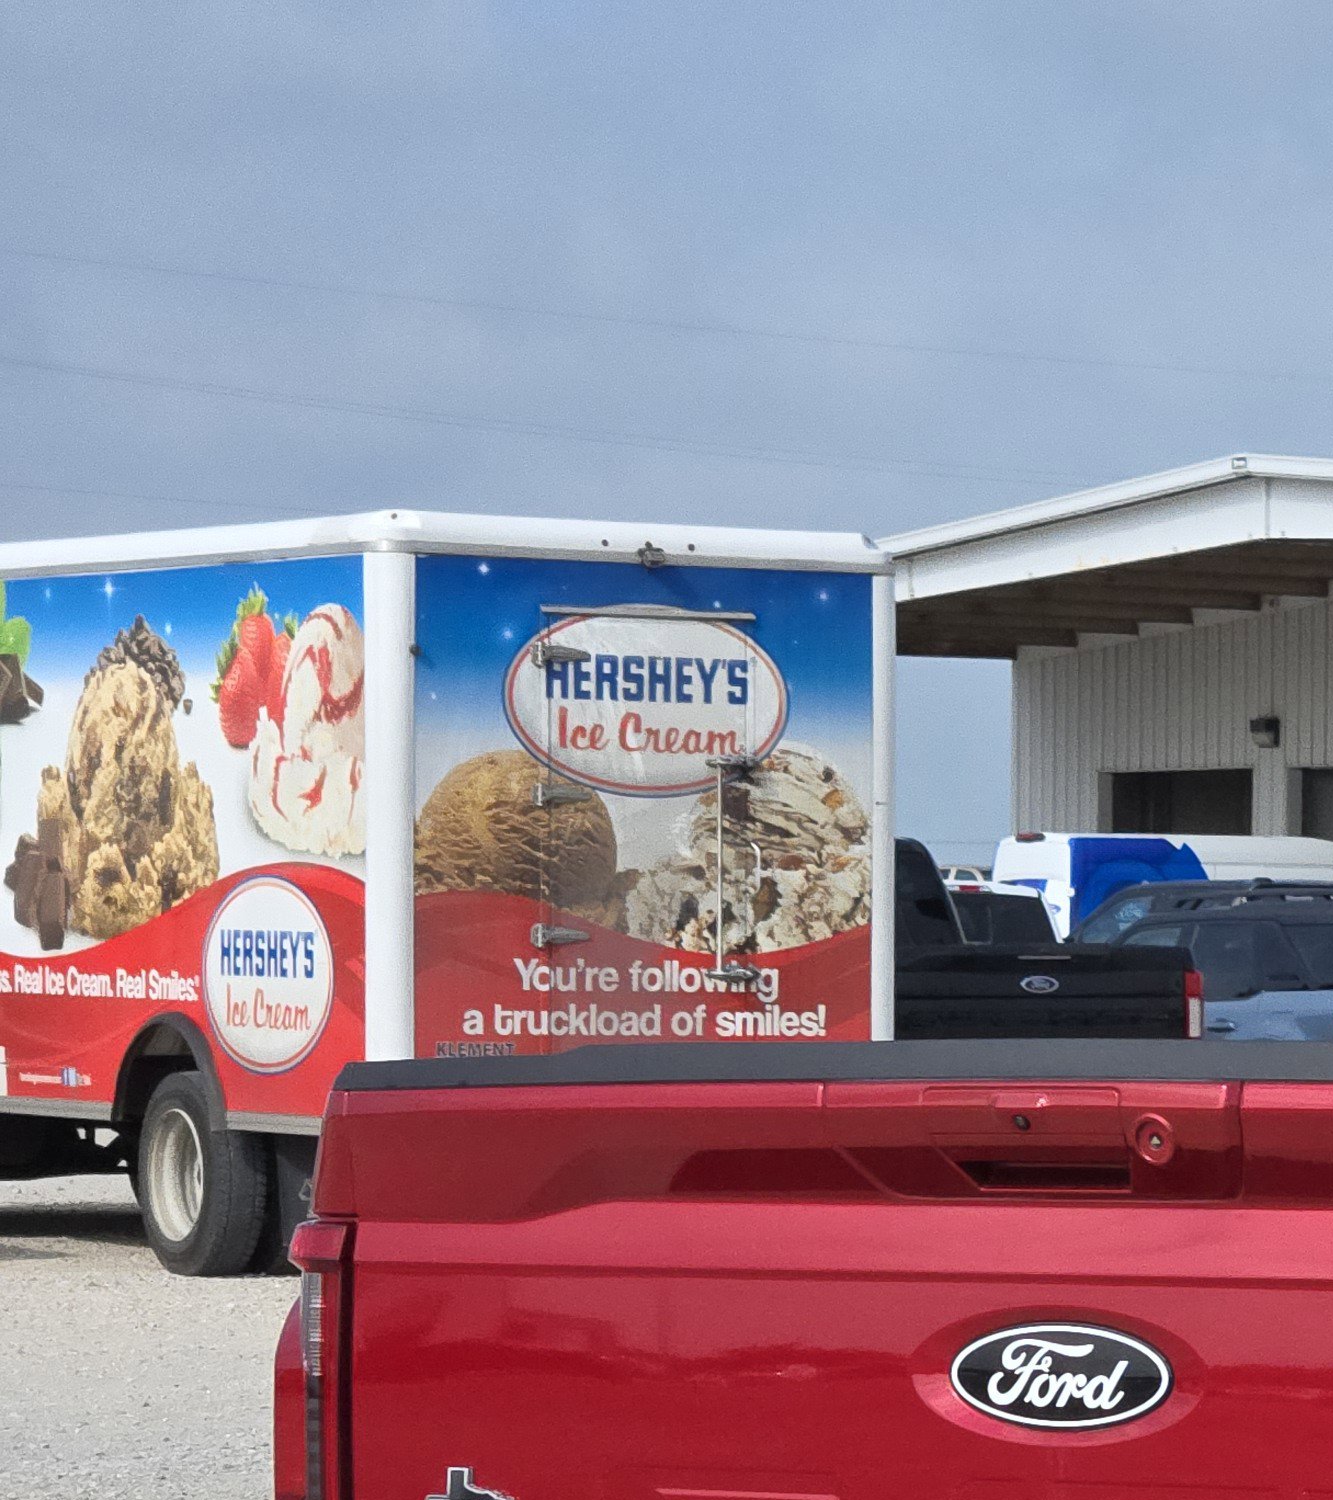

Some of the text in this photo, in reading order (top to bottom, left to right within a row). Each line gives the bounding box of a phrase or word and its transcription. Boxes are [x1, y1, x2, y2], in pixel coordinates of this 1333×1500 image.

[545, 653, 749, 706] HERSHEY'S
[558, 706, 744, 756] Ice Cream
[220, 929, 315, 979] HERSHEY'S
[513, 957, 620, 992] You're
[14, 962, 43, 994] Real
[45, 965, 66, 995] Ice
[66, 965, 114, 997] Cream.
[116, 967, 146, 999] Real
[226, 982, 311, 1031] Ice Cream
[462, 1003, 827, 1037] a truckload of smiles!
[436, 1042, 515, 1057] KLEMENT
[987, 1338, 1129, 1410] Ford
